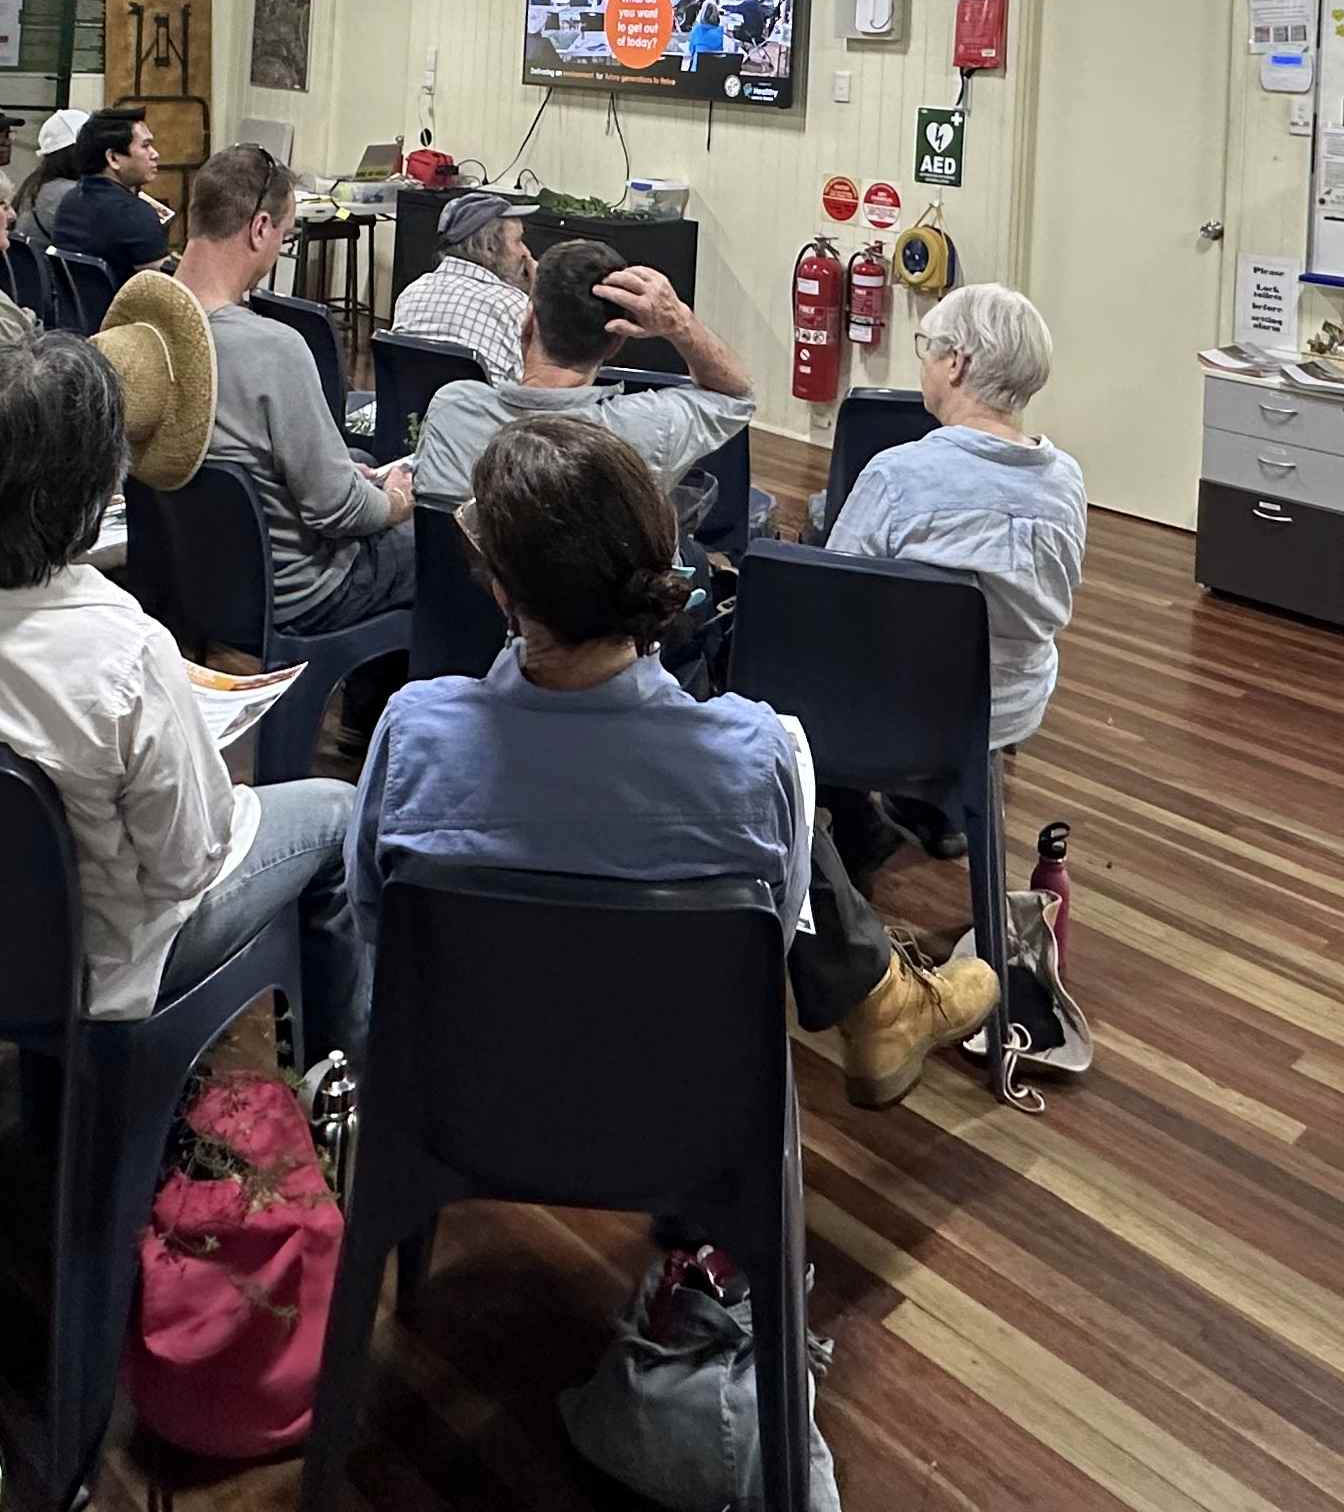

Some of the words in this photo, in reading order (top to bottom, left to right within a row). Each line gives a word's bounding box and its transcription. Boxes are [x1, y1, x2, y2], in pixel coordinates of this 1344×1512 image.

[618, 9, 636, 20] you
[637, 7, 658, 18] want
[617, 21, 626, 33] to
[628, 22, 643, 35] get
[643, 22, 658, 34] out
[616, 35, 626, 47] of
[627, 36, 658, 50] today?
[920, 154, 956, 175] AED
[1253, 266, 1284, 276] Please
[1252, 302, 1282, 313] before
